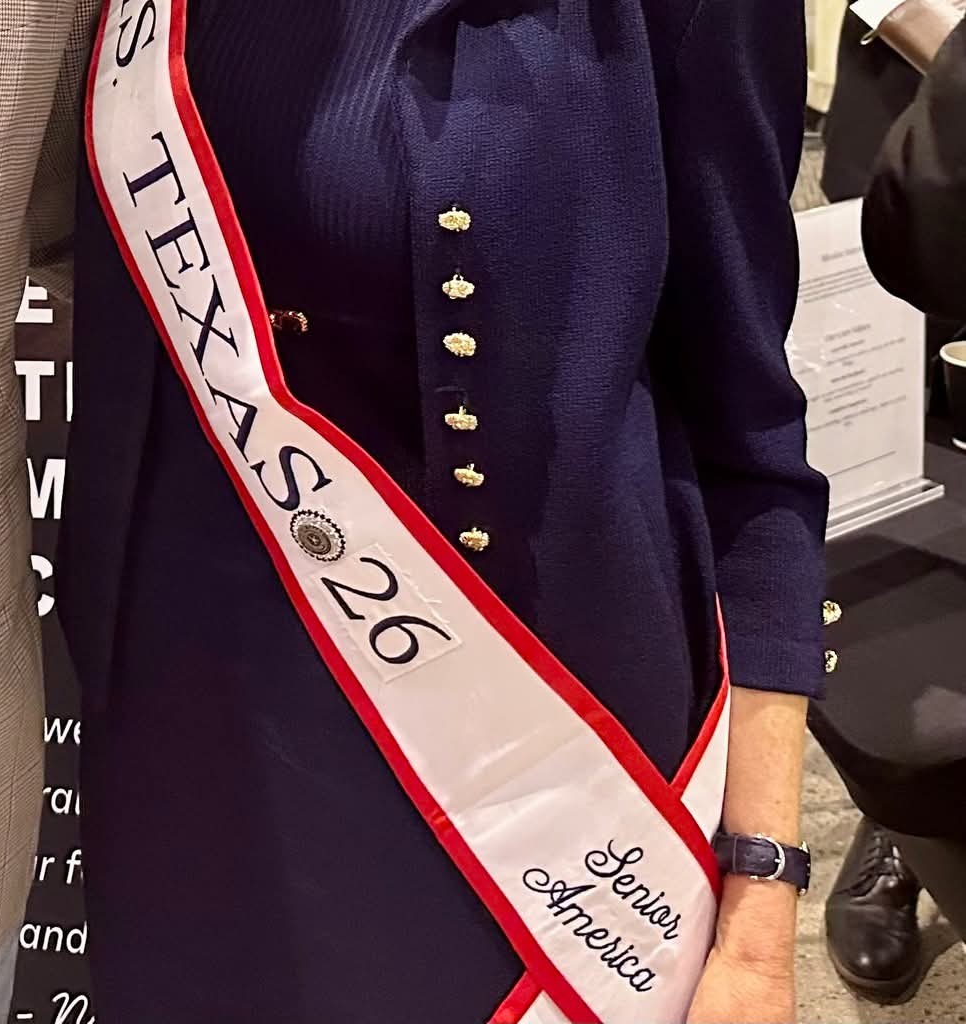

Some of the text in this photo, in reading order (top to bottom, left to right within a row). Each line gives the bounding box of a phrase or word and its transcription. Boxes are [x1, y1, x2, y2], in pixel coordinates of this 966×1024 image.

[122, 131, 333, 512] TEXAS
[320, 556, 452, 665] 26
[522, 867, 657, 993] America
[584, 838, 682, 940] Senior
